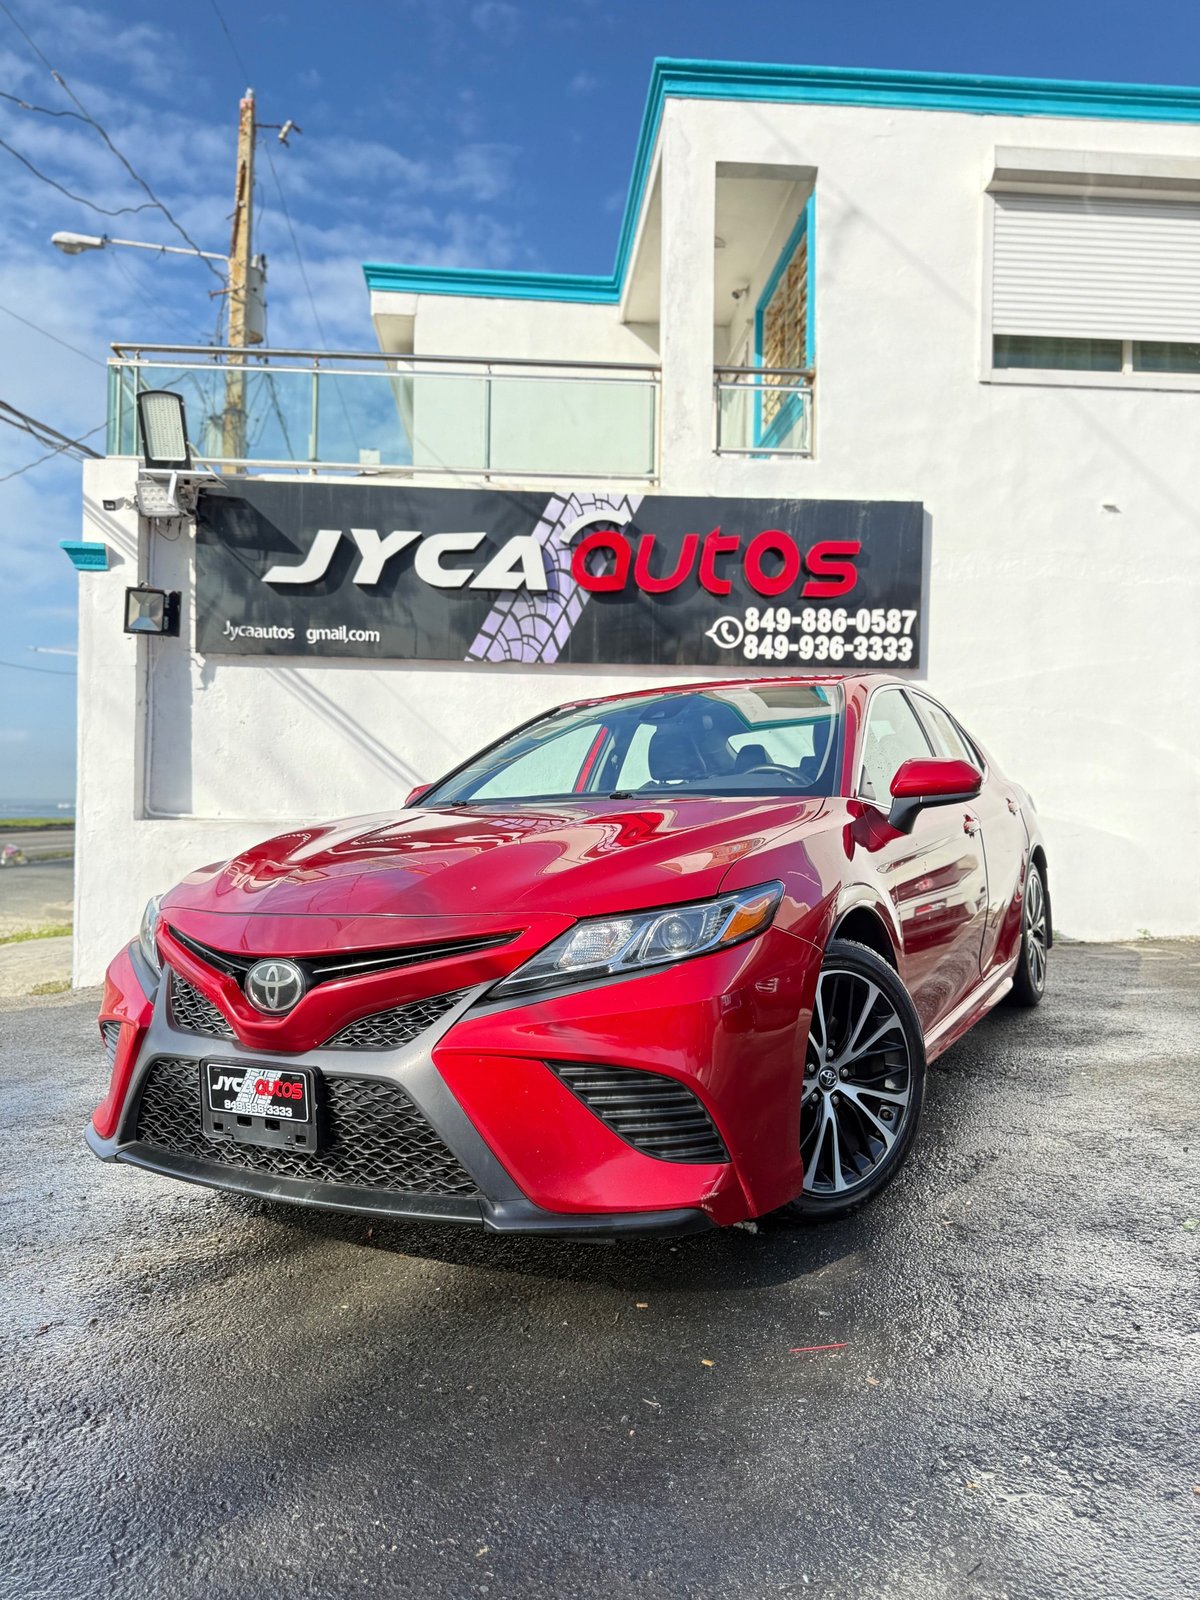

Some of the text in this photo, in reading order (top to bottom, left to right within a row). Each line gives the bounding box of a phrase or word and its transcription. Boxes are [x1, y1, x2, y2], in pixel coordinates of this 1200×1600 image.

[261, 526, 861, 598] JYCA autos
[222, 620, 295, 641] Jycaautos
[744, 607, 917, 634] 849-886-0587
[743, 634, 914, 661] 849-936-3333
[212, 1076, 303, 1100] JYCA autos
